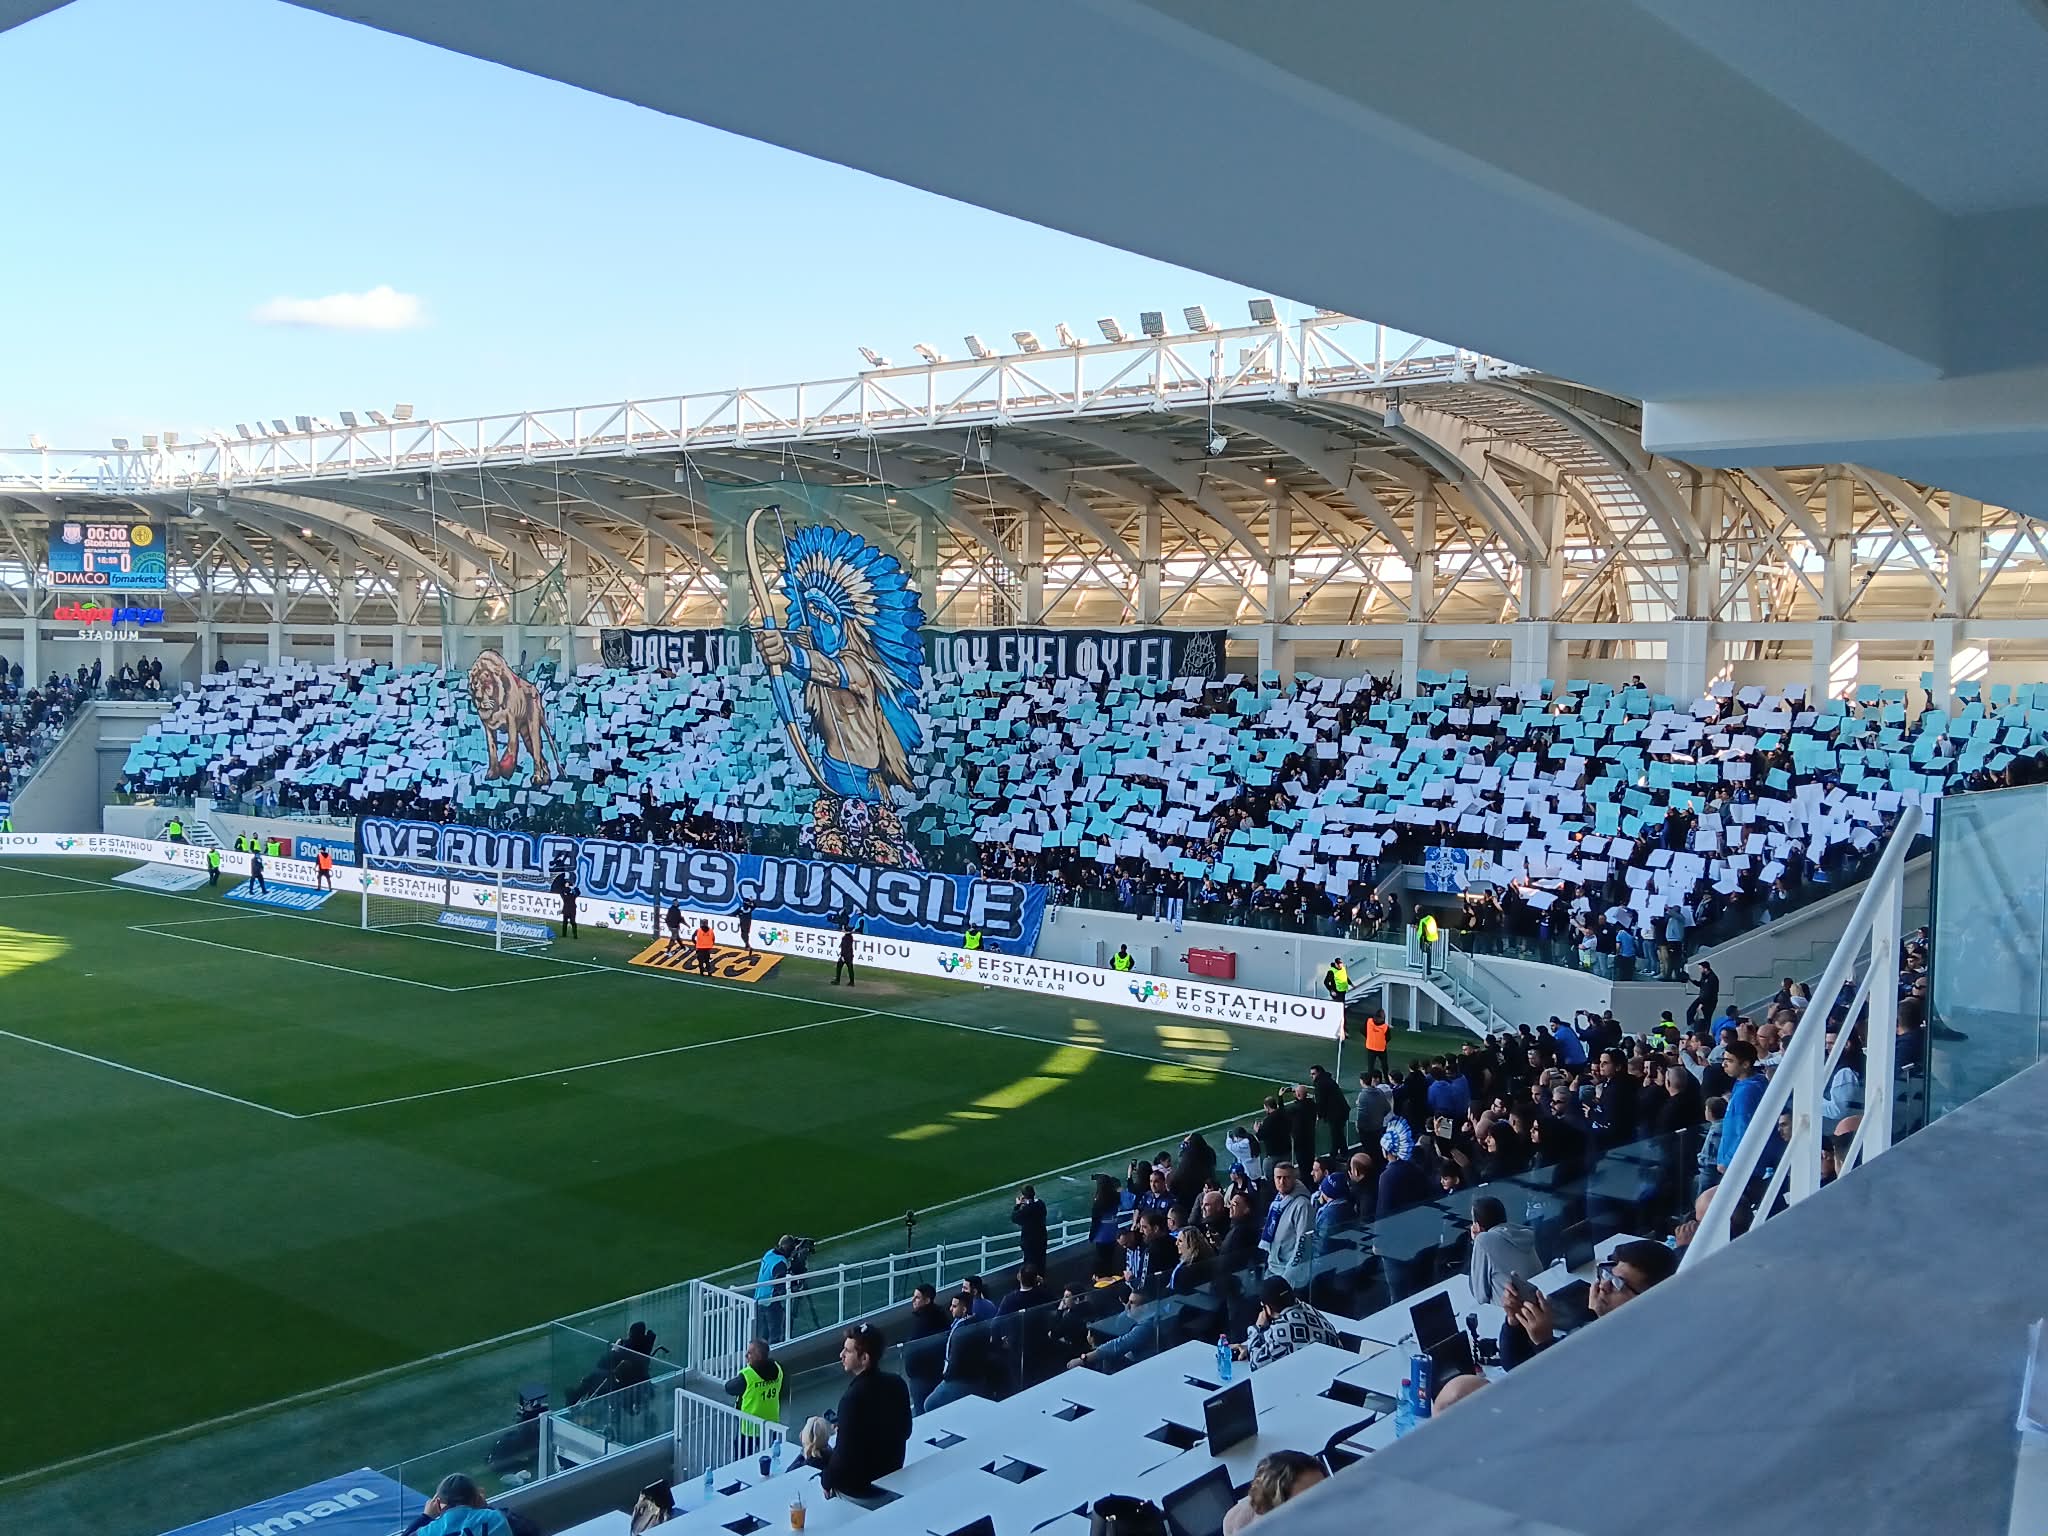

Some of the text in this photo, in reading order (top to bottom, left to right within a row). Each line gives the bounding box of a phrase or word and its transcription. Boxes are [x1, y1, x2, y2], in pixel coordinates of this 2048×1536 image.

[87, 528, 127, 540] 00:00
[84, 553, 94, 572] 0
[121, 553, 131, 573] 0
[55, 572, 105, 584] DIMCO
[112, 574, 157, 584] fpmarkets
[78, 630, 139, 641] STADIUM
[89, 838, 152, 852] EFSTATHIOU
[184, 849, 243, 864] EFSTHIOU
[365, 825, 434, 864] WE
[583, 843, 728, 897] THIS
[741, 861, 1014, 931] JUNGLE
[501, 892, 588, 913] EFSTATHU
[795, 931, 911, 958] EFSTTHIOU
[795, 944, 874, 962] WORKAR
[978, 957, 1105, 987] EFSTATHIOU
[978, 971, 1065, 991] WORKWEAR
[1176, 986, 1326, 1020] EFSTATHIOU
[1176, 1001, 1278, 1024] WORKWEAR
[761, 1387, 777, 1401] 149
